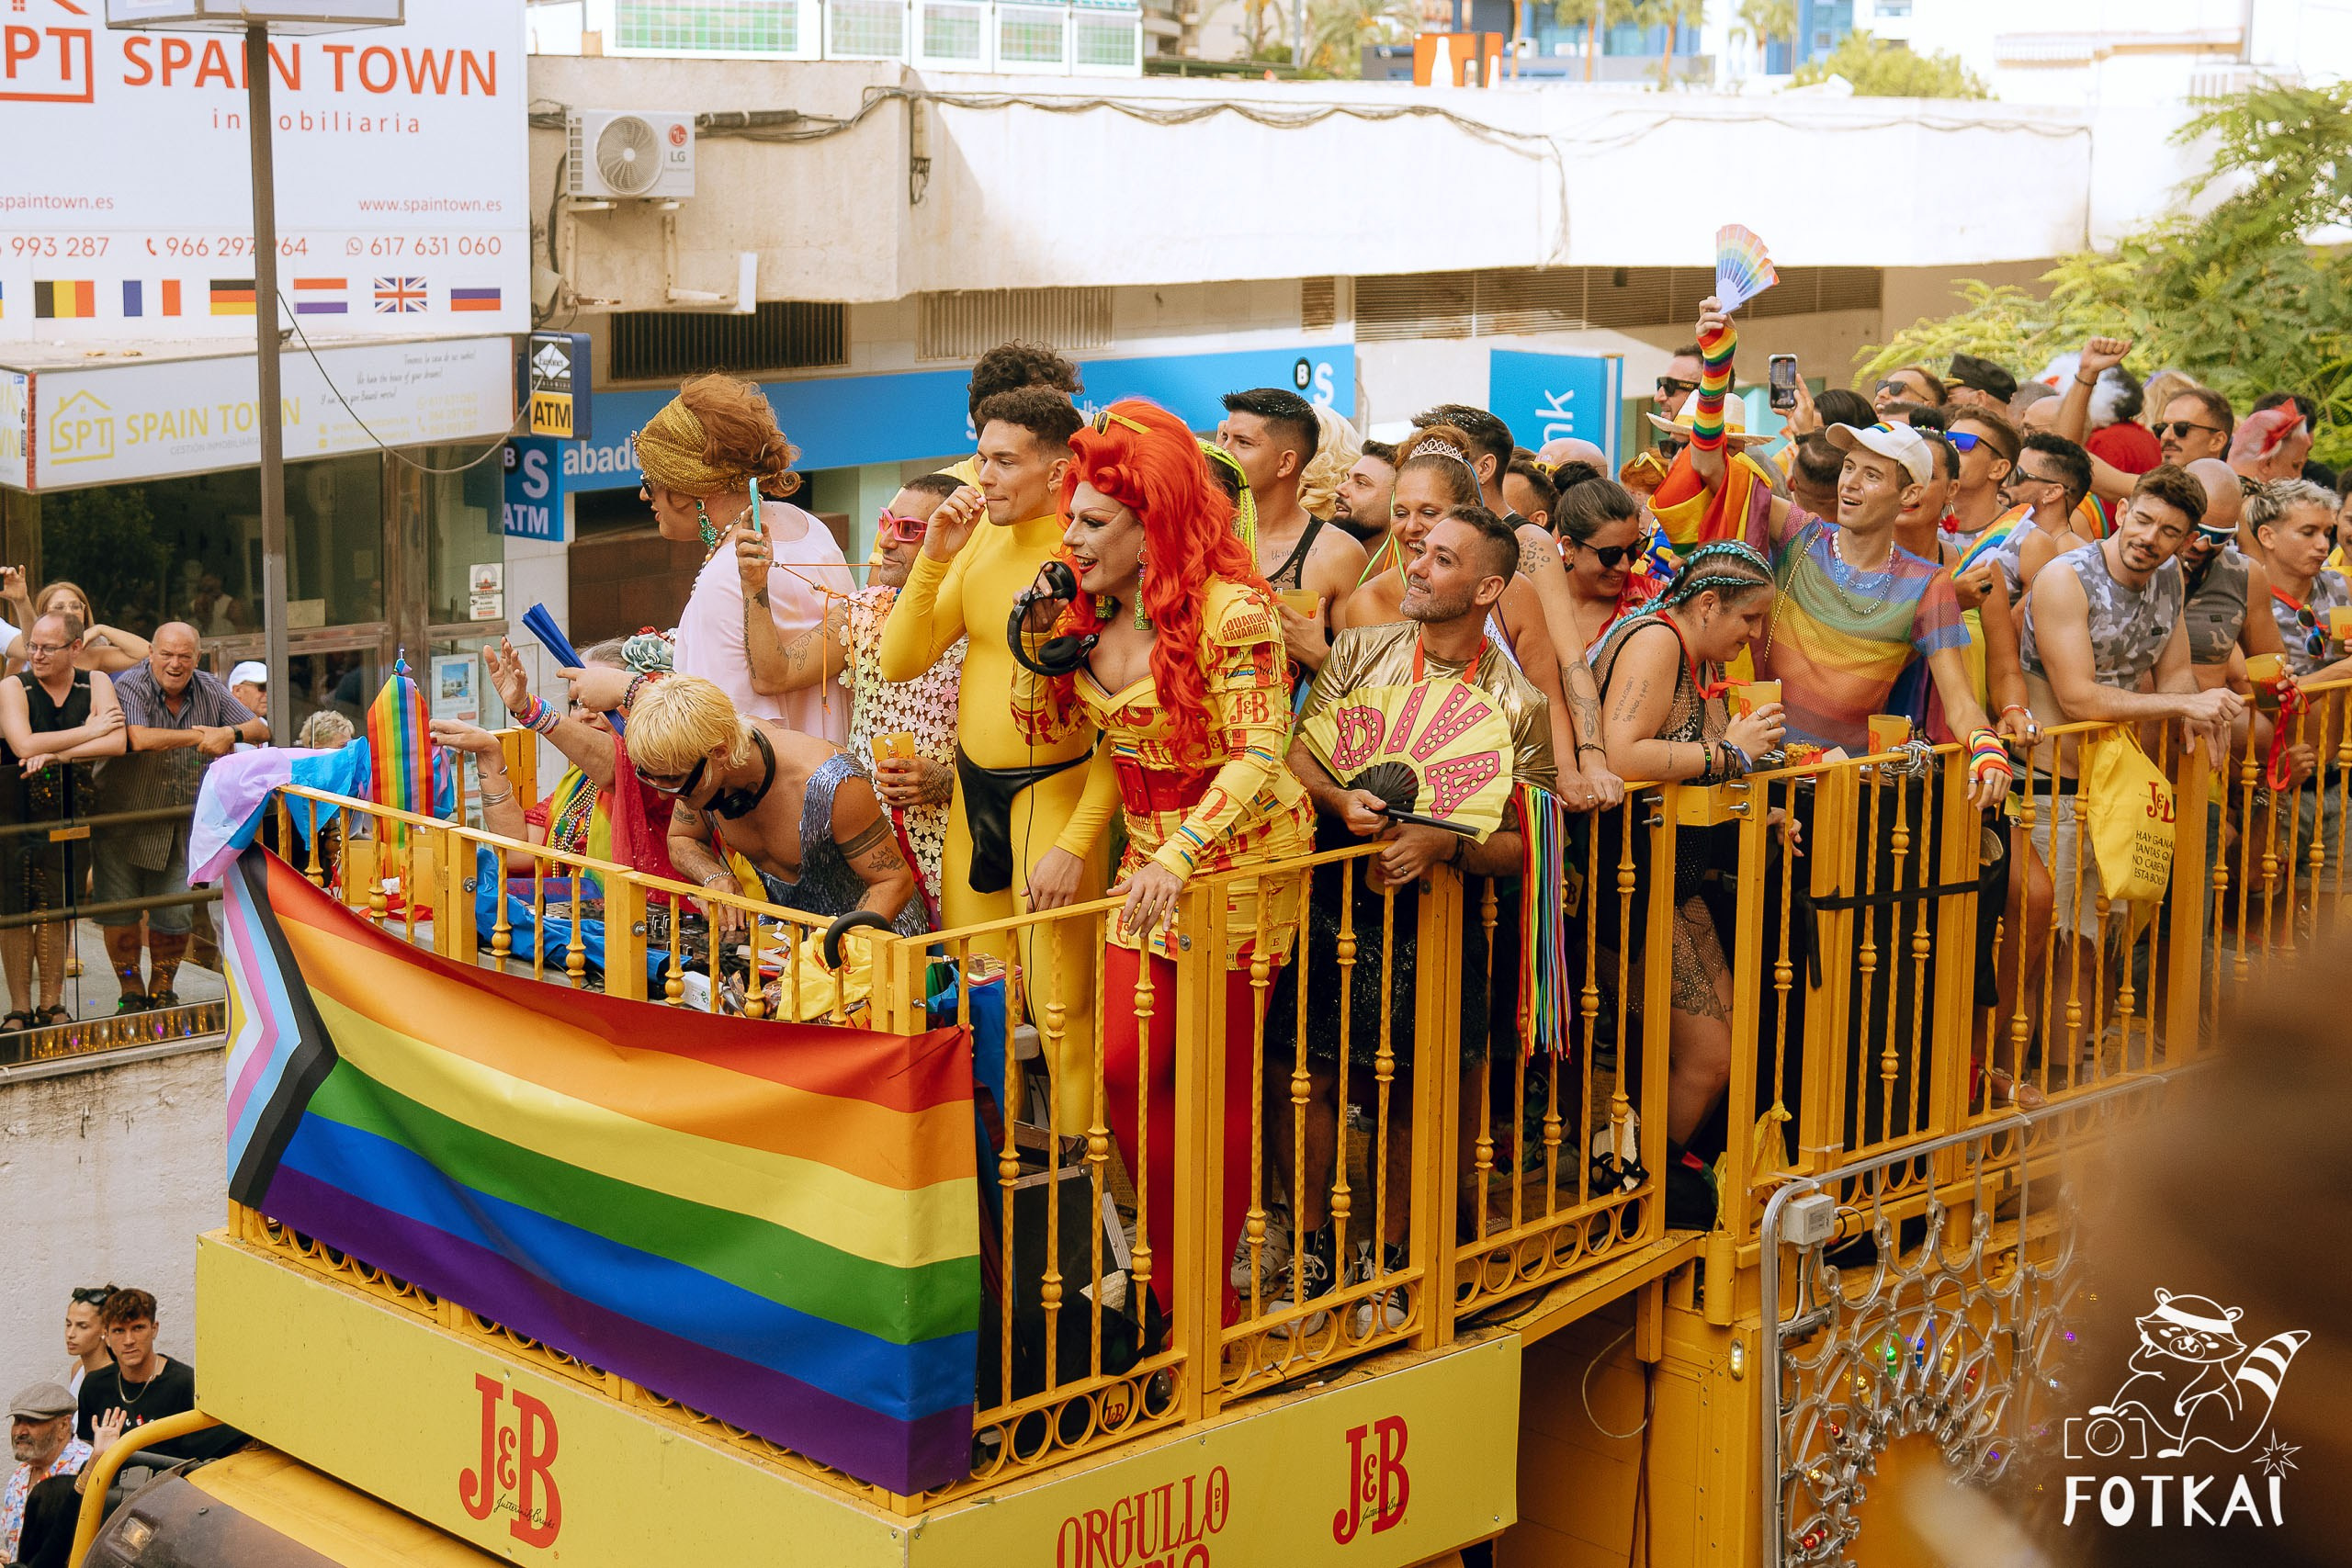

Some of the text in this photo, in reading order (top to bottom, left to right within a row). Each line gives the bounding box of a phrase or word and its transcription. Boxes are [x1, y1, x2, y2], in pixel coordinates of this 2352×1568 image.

[322, 44, 497, 96] TOWN
[213, 108, 420, 133] inobiliaria
[671, 151, 686, 163] LG
[358, 197, 503, 213] www.spaintown.es
[11, 236, 110, 257] 993 287
[166, 236, 209, 257] 966
[276, 236, 309, 256] 64
[370, 236, 502, 256] 617 631 060
[1296, 361, 1335, 407] B S
[126, 396, 301, 446] SPAIN TON
[533, 400, 571, 429] ATM
[58, 418, 111, 452] SPT
[522, 449, 550, 500] S
[503, 502, 549, 536] ATM
[1222, 622, 1270, 642] NAVARRET
[1229, 691, 1270, 724] J&B
[1329, 681, 1501, 820] DIVA
[2134, 841, 2160, 859] TANTAS
[2135, 829, 2152, 843] HAY
[2132, 854, 2143, 865] NO
[458, 1371, 562, 1550] J&B
[1332, 1415, 1410, 1546] J&B
[1057, 1464, 1230, 1568] ORGULLO
